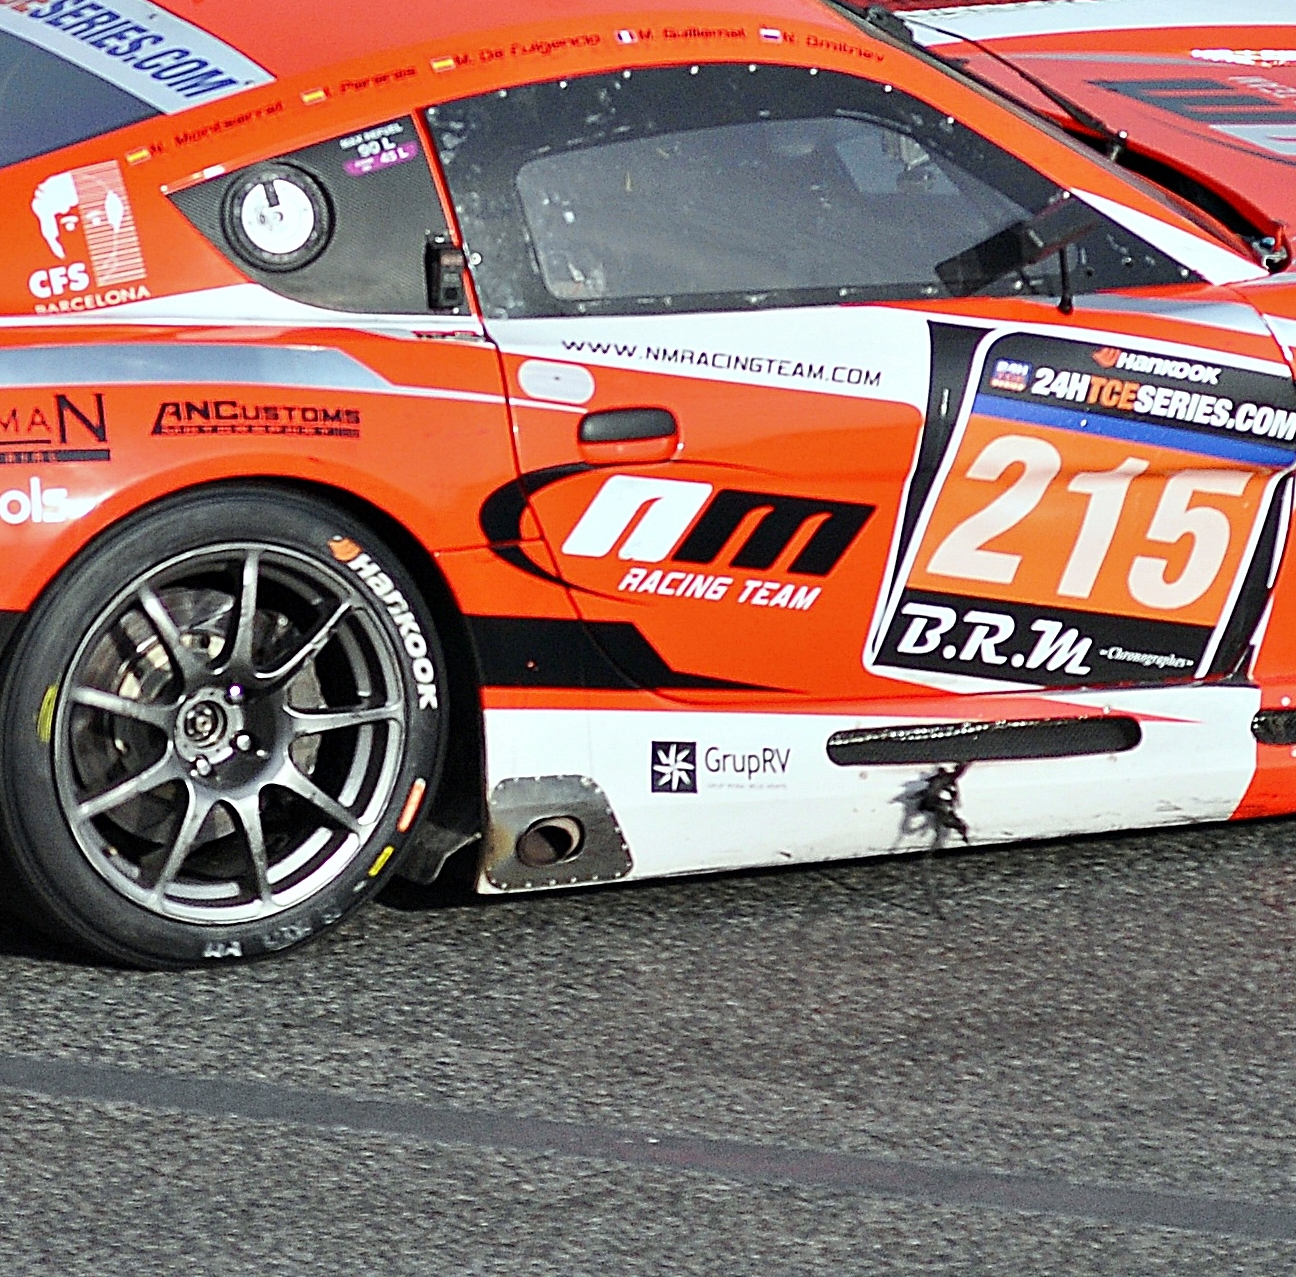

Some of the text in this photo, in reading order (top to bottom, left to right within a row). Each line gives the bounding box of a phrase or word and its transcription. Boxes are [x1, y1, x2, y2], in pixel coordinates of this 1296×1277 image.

[28, 261, 91, 300] CFS
[33, 284, 153, 315] BARCELONA
[561, 339, 883, 388] WWW.NMRACINGTEAM.COM
[926, 434, 1254, 610] 215
[617, 568, 822, 612] RACING TEAM
[704, 746, 791, 781] GrupRV
